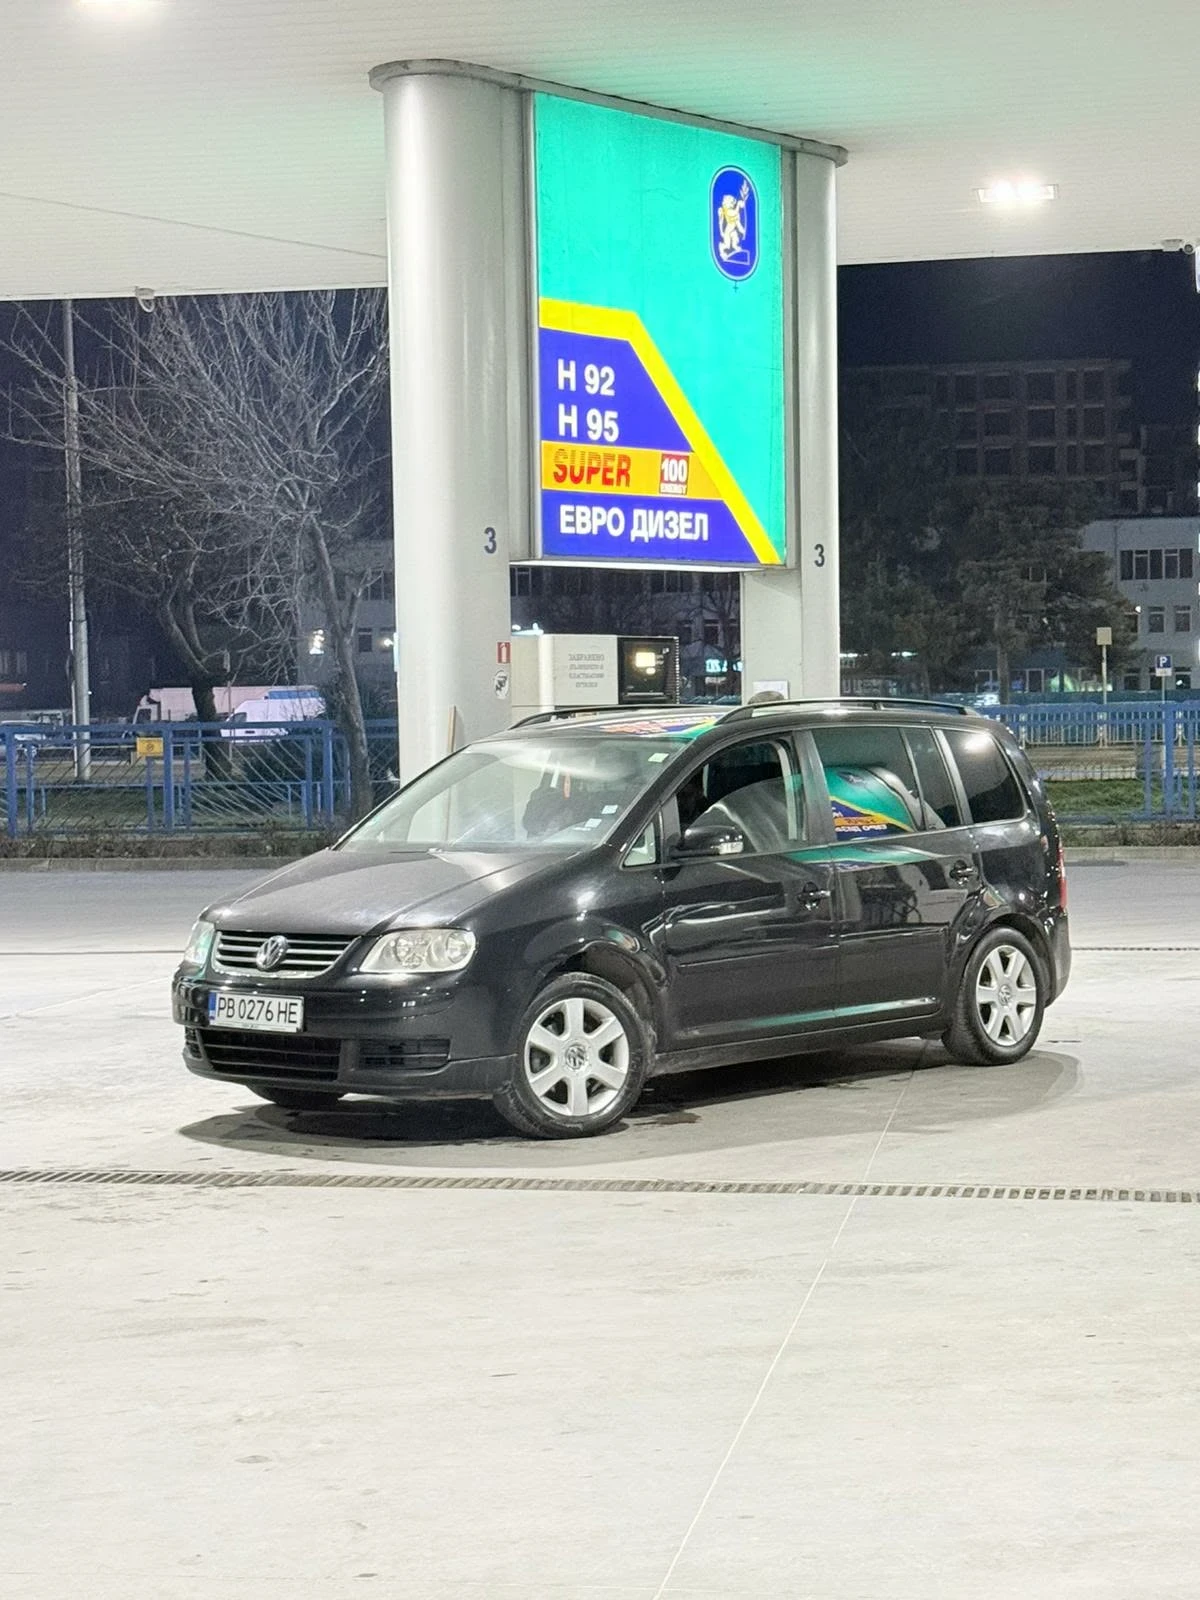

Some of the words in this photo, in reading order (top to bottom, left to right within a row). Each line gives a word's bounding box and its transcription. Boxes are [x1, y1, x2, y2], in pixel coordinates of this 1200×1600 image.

[584, 363, 616, 396] 92
[586, 408, 620, 442] 95
[553, 448, 632, 488] SUPER
[661, 458, 688, 482] 100
[559, 504, 626, 537] ЕВРО
[630, 508, 709, 543] ДИЗЕЛ
[483, 526, 497, 554] 3
[814, 543, 825, 568] 3
[1159, 656, 1168, 668] P
[238, 999, 274, 1022] 0276
